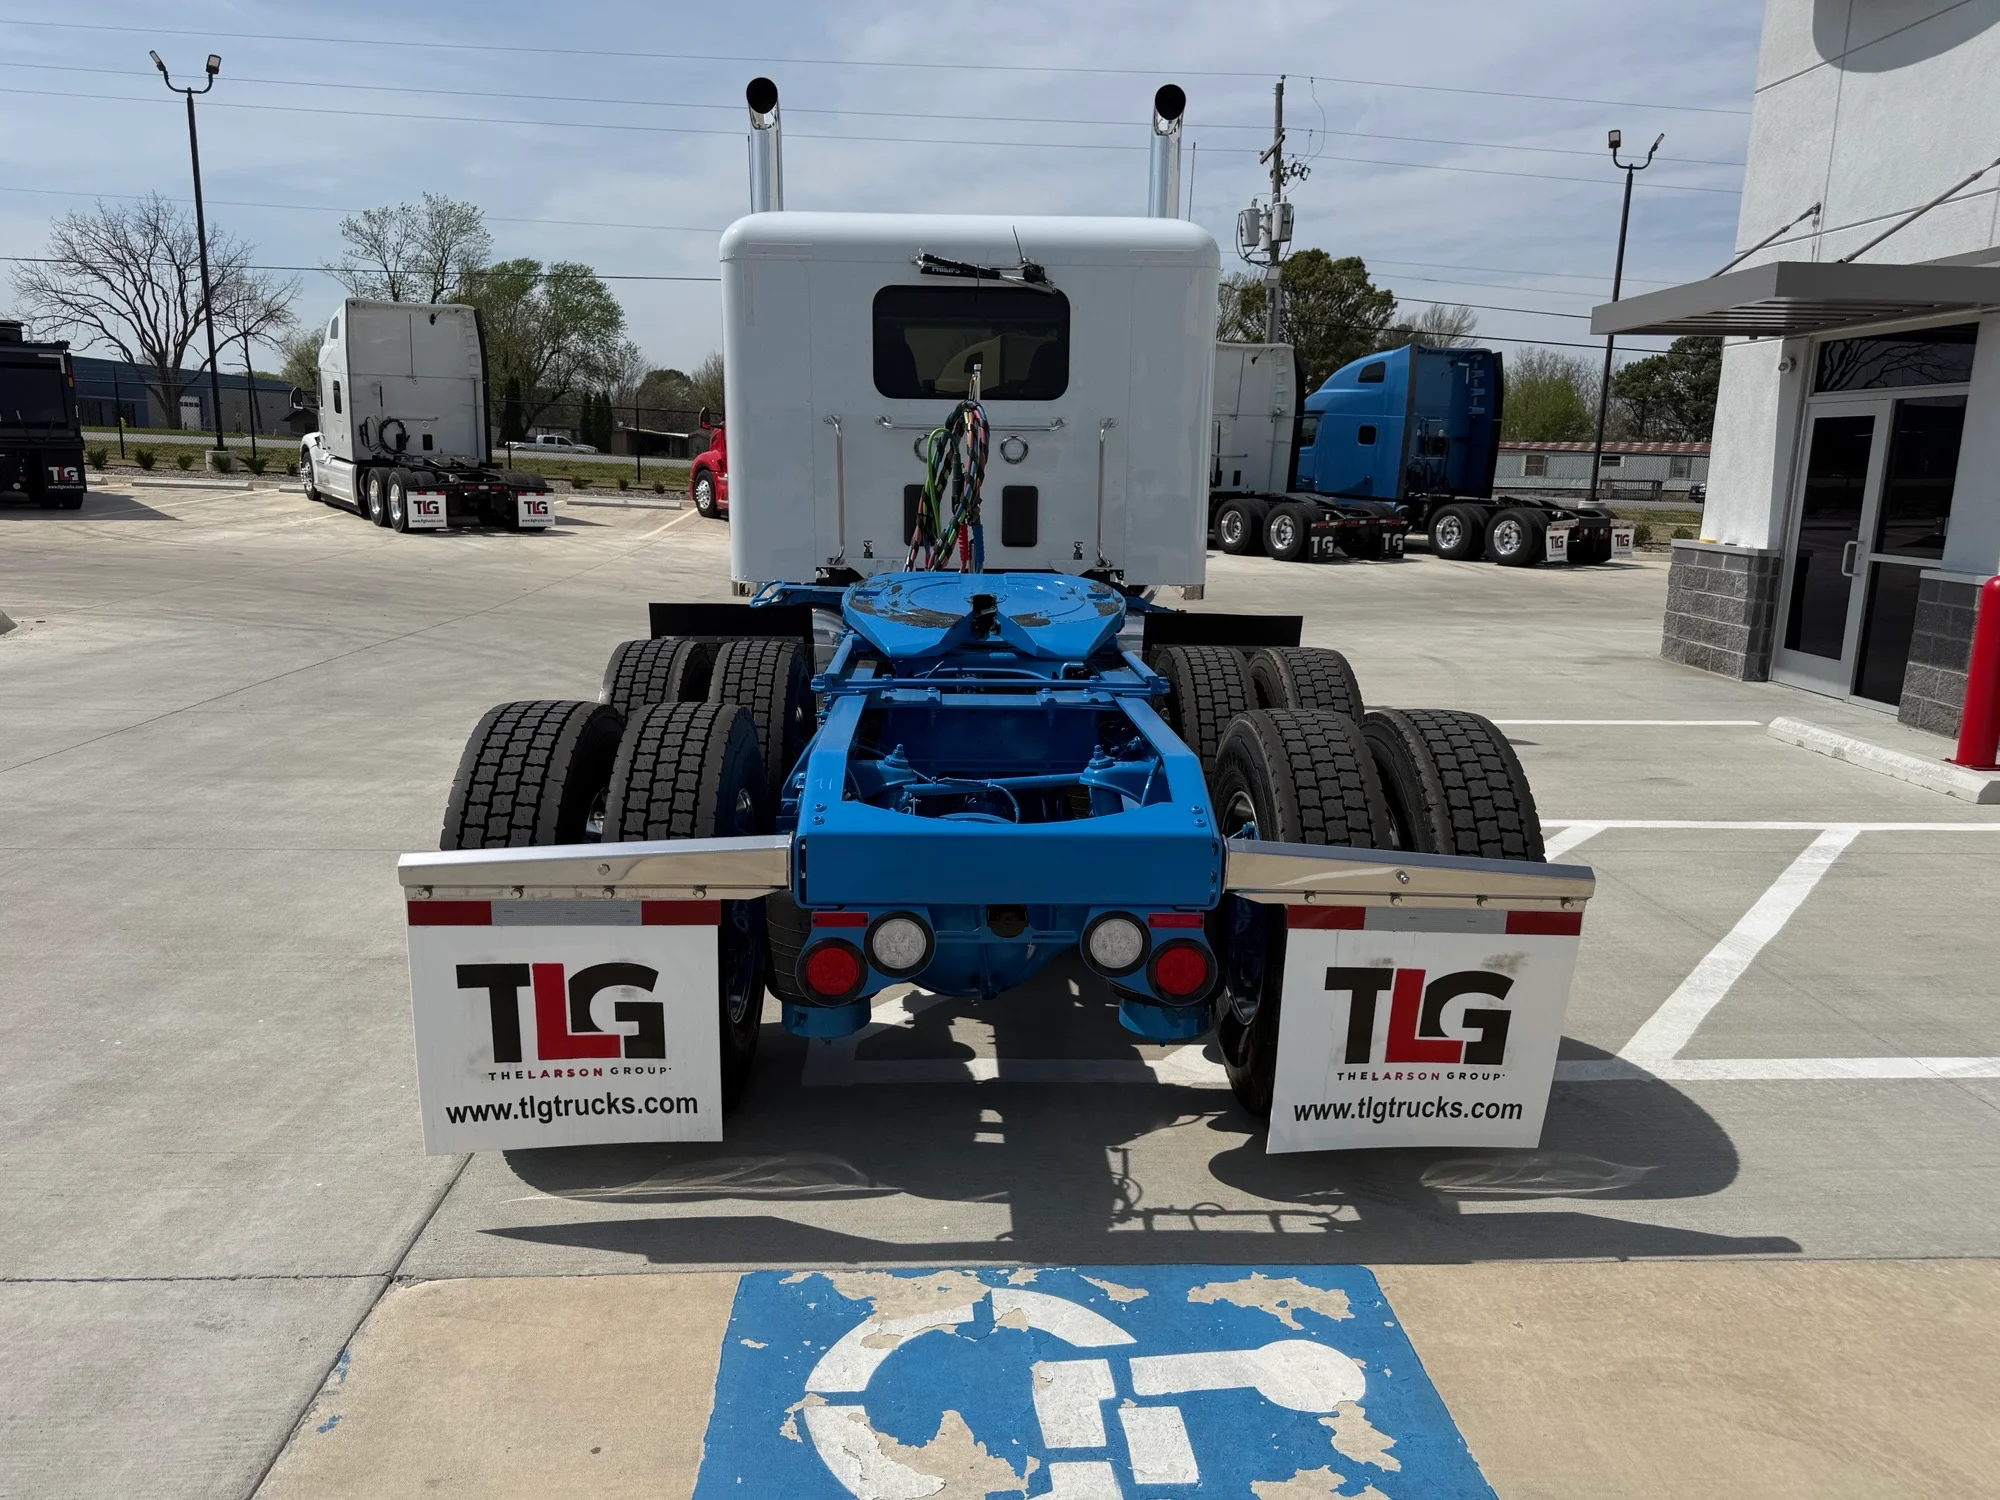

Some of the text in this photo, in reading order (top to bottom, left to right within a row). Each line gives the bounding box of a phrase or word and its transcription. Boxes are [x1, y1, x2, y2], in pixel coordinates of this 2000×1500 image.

[48, 466, 79, 481] TLG
[413, 500, 440, 515] TLG
[523, 501, 549, 515] TLG
[1311, 536, 1334, 554] TG
[1382, 533, 1404, 551] TG
[1549, 535, 1564, 549] TLG
[1614, 534, 1630, 547] TLG
[456, 962, 666, 1064] TLG
[1324, 966, 1515, 1065] TLG
[610, 1066, 667, 1075] GROUP
[1446, 1071, 1501, 1081] GROUP
[446, 1092, 699, 1124] www.tlgtrucks.com
[1294, 1096, 1523, 1124] www.tlgtrucks.com
